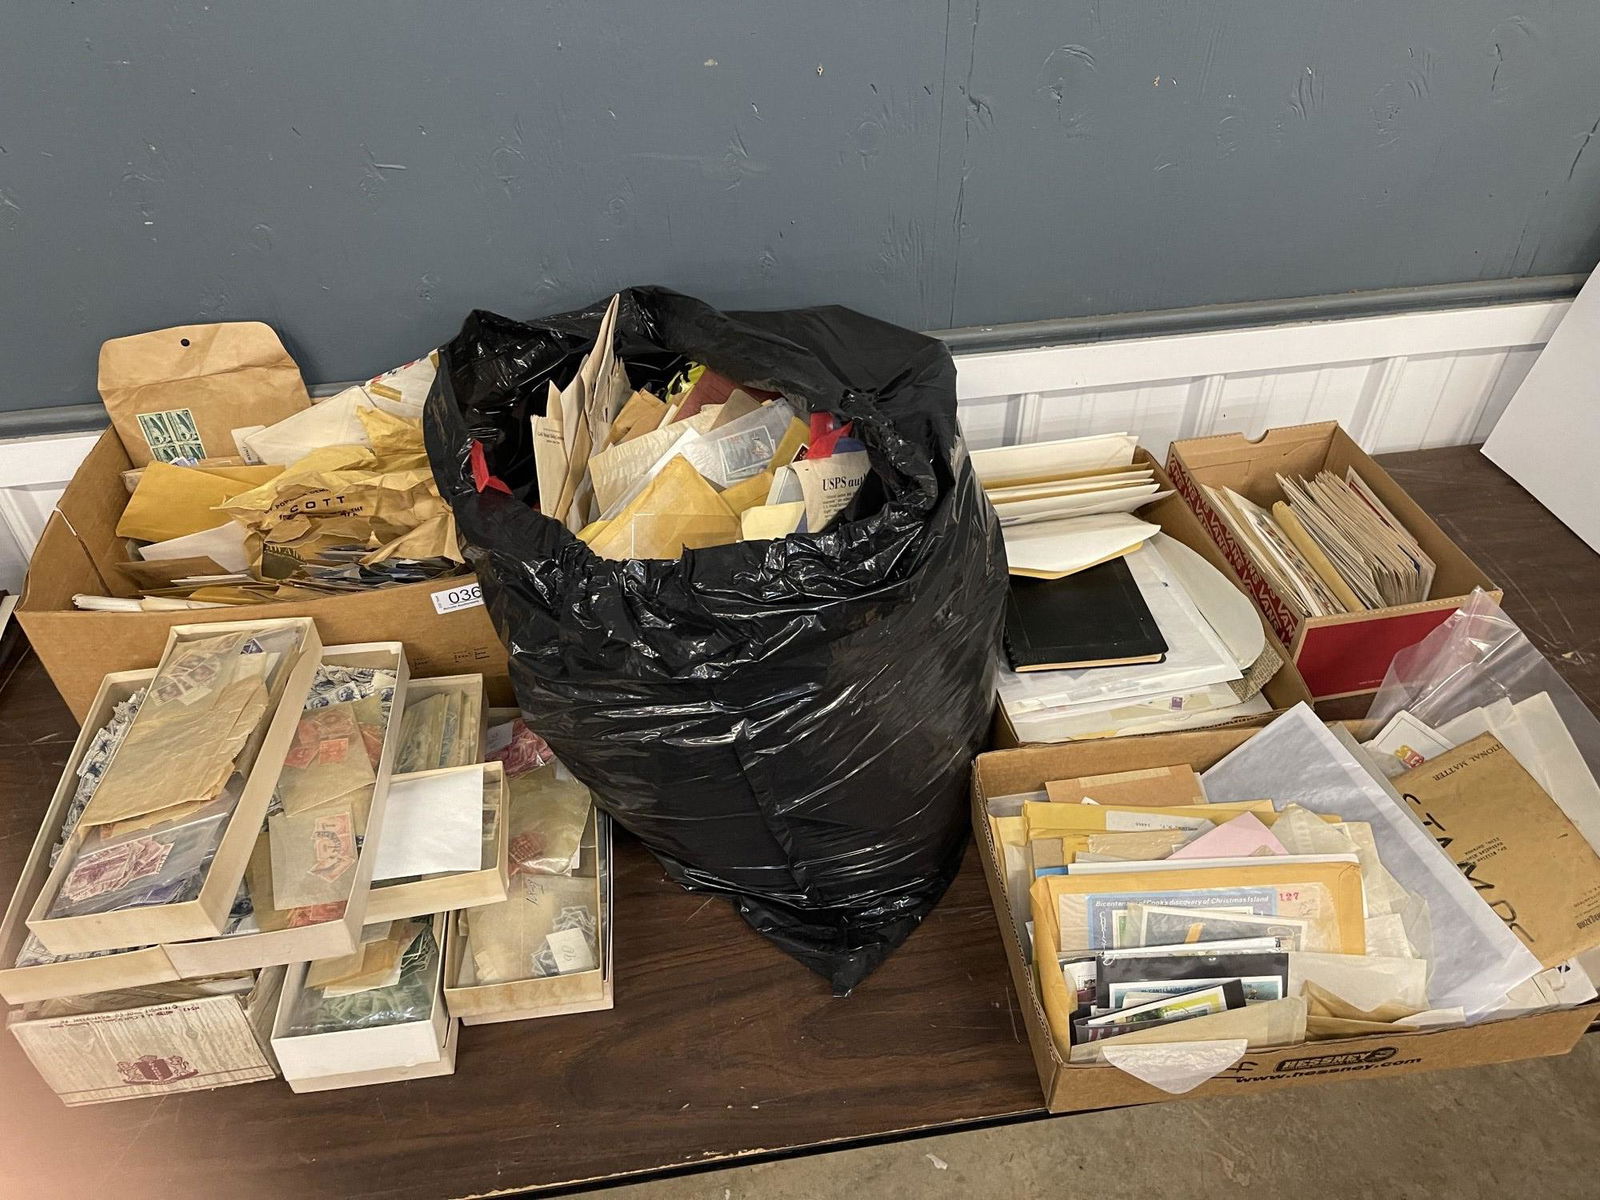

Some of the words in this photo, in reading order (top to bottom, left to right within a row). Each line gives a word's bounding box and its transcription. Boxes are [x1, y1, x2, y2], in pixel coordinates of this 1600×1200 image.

[823, 476, 847, 491] USPS
[448, 586, 481, 604] 036
[1277, 601, 1297, 638] VAN
[1432, 759, 1470, 782] MATTER
[1169, 898, 1203, 908] discovery
[1211, 896, 1247, 905] Christmas
[1247, 895, 1269, 904] Island
[1279, 891, 1300, 901] 127
[1236, 1058, 1422, 1083] www.hessney.com
